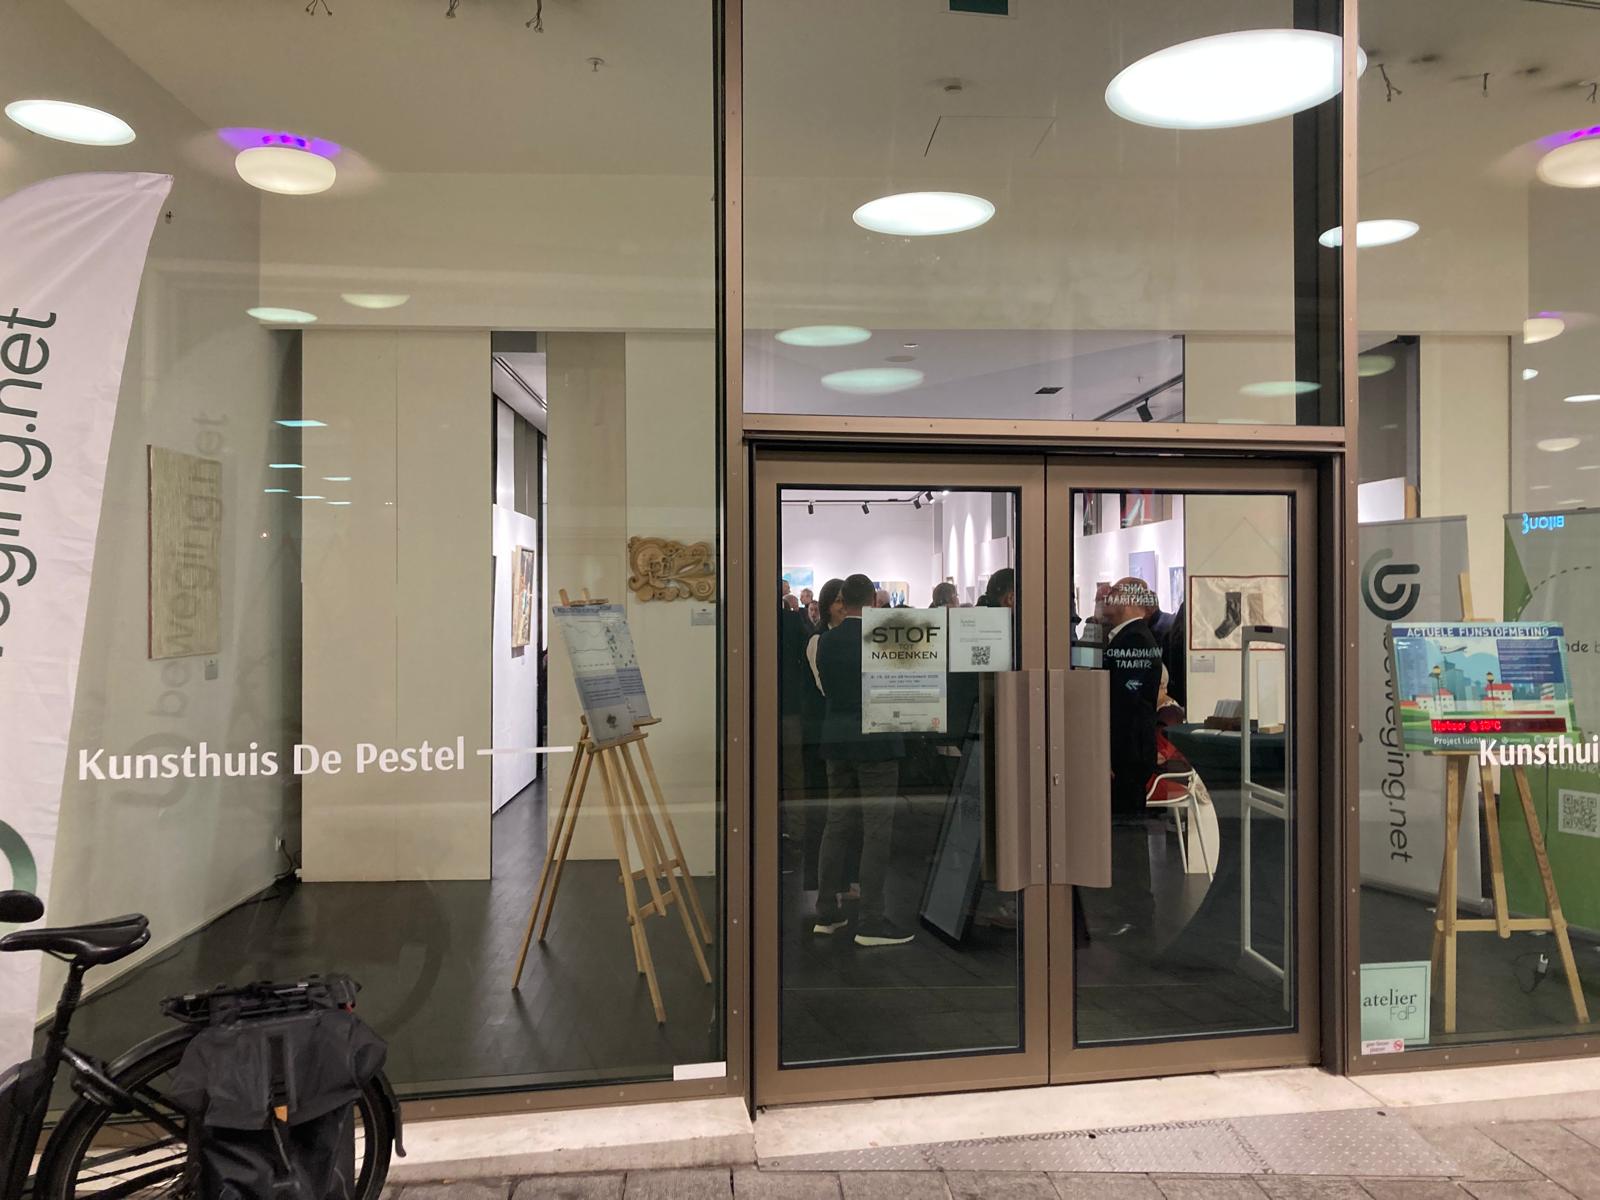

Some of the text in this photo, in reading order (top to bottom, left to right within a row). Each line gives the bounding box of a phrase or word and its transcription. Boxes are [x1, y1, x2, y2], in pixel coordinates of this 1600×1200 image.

[871, 626, 941, 644] STOF
[1406, 626, 1550, 638] ACTUELE FIJNSTOFMETING
[871, 651, 938, 660] NADENKEN
[1433, 736, 1461, 746] Project
[79, 736, 465, 780] Kunsthuis De Pestel
[1480, 735, 1599, 767] Kunsthui
[1363, 988, 1418, 1007] atelier
